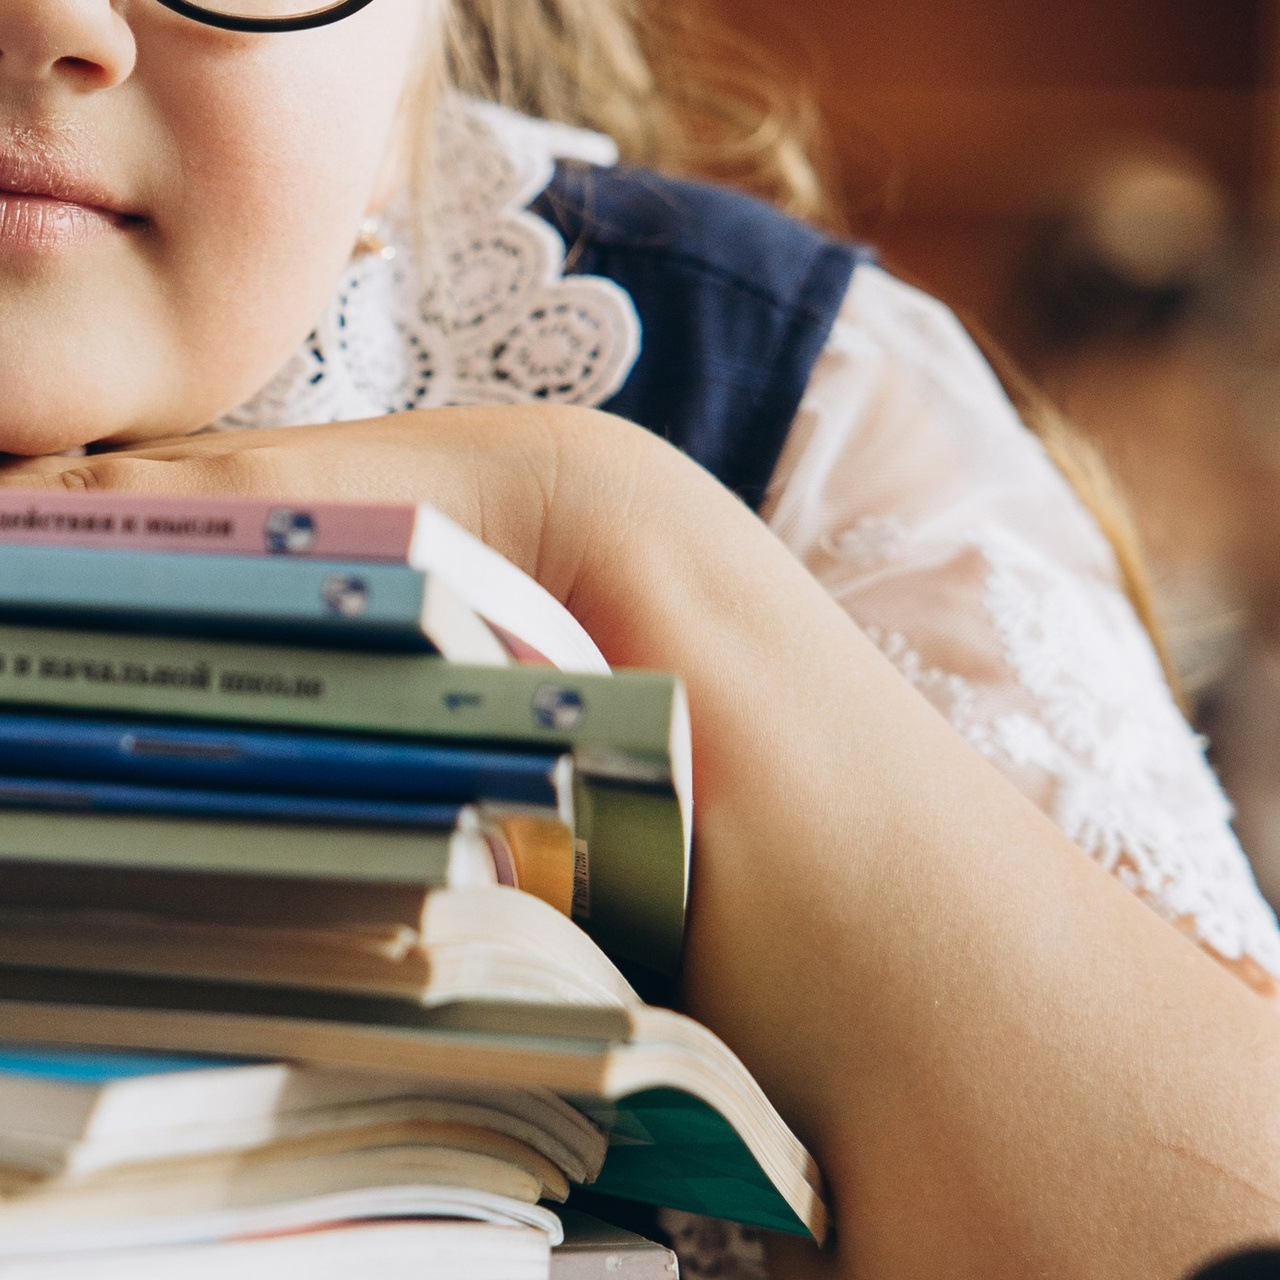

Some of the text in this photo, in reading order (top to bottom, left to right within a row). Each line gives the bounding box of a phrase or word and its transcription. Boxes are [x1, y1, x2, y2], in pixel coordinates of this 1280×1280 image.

[14, 654, 31, 678] в
[37, 655, 212, 691] начальной
[219, 668, 327, 699] школе
